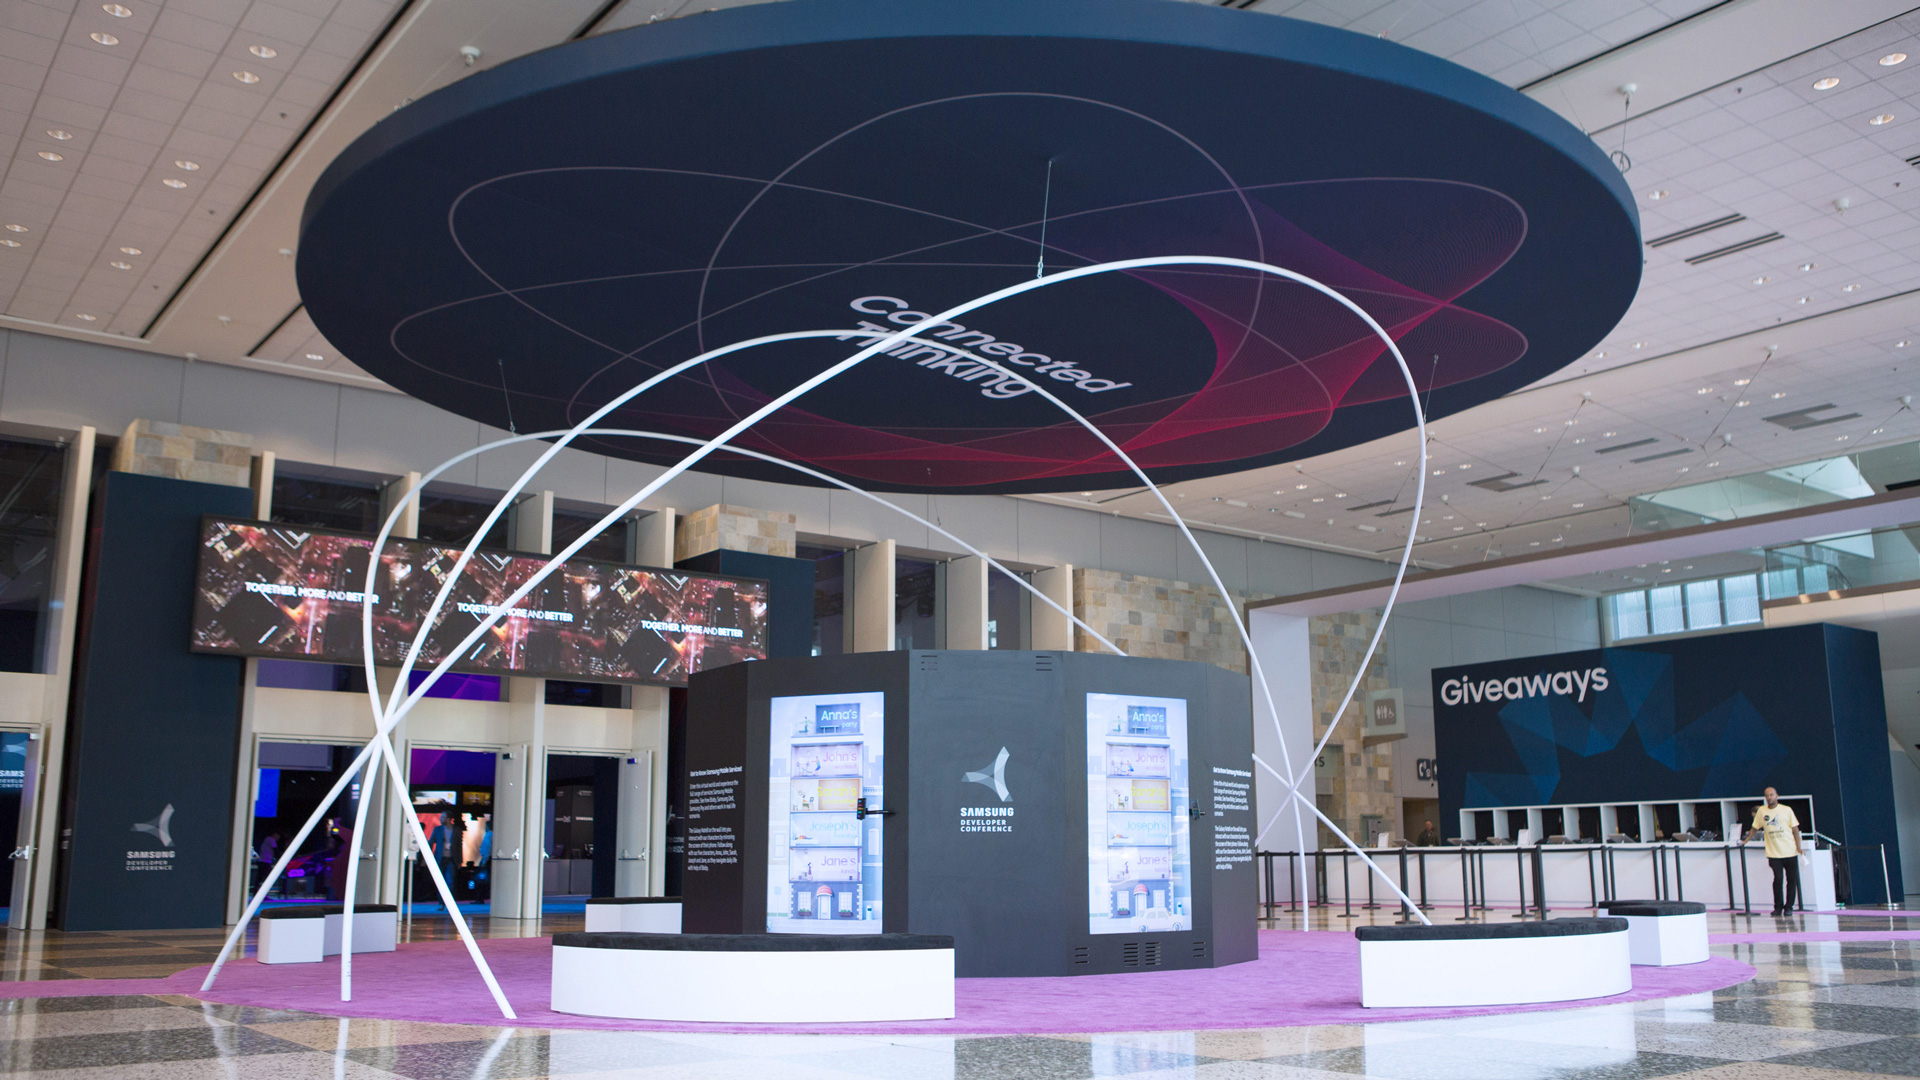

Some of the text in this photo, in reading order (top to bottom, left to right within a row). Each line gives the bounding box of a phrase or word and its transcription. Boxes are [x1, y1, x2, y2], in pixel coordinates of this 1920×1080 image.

[850, 296, 1132, 393] Connected
[245, 581, 380, 604] TOGETHER, MORE AND BETR
[528, 610, 545, 620] AND
[545, 611, 574, 622] BETTER
[641, 620, 744, 638] TOGETHER, MORE AND BETTER
[1441, 667, 1609, 706] Giveaways
[821, 710, 858, 721] Anna's
[1132, 711, 1165, 723] Anna's
[842, 721, 858, 729] party
[1151, 724, 1165, 732] party
[823, 751, 857, 763] John's
[1135, 752, 1166, 763] John's
[817, 786, 857, 798] Sarah's
[1131, 786, 1166, 797] Sarah's
[960, 807, 1014, 817] SAMSUNG
[809, 821, 857, 834] Joseph's
[1125, 820, 1167, 833] Joseph's
[821, 856, 857, 867] Jane's
[1137, 855, 1167, 866] Jane's
